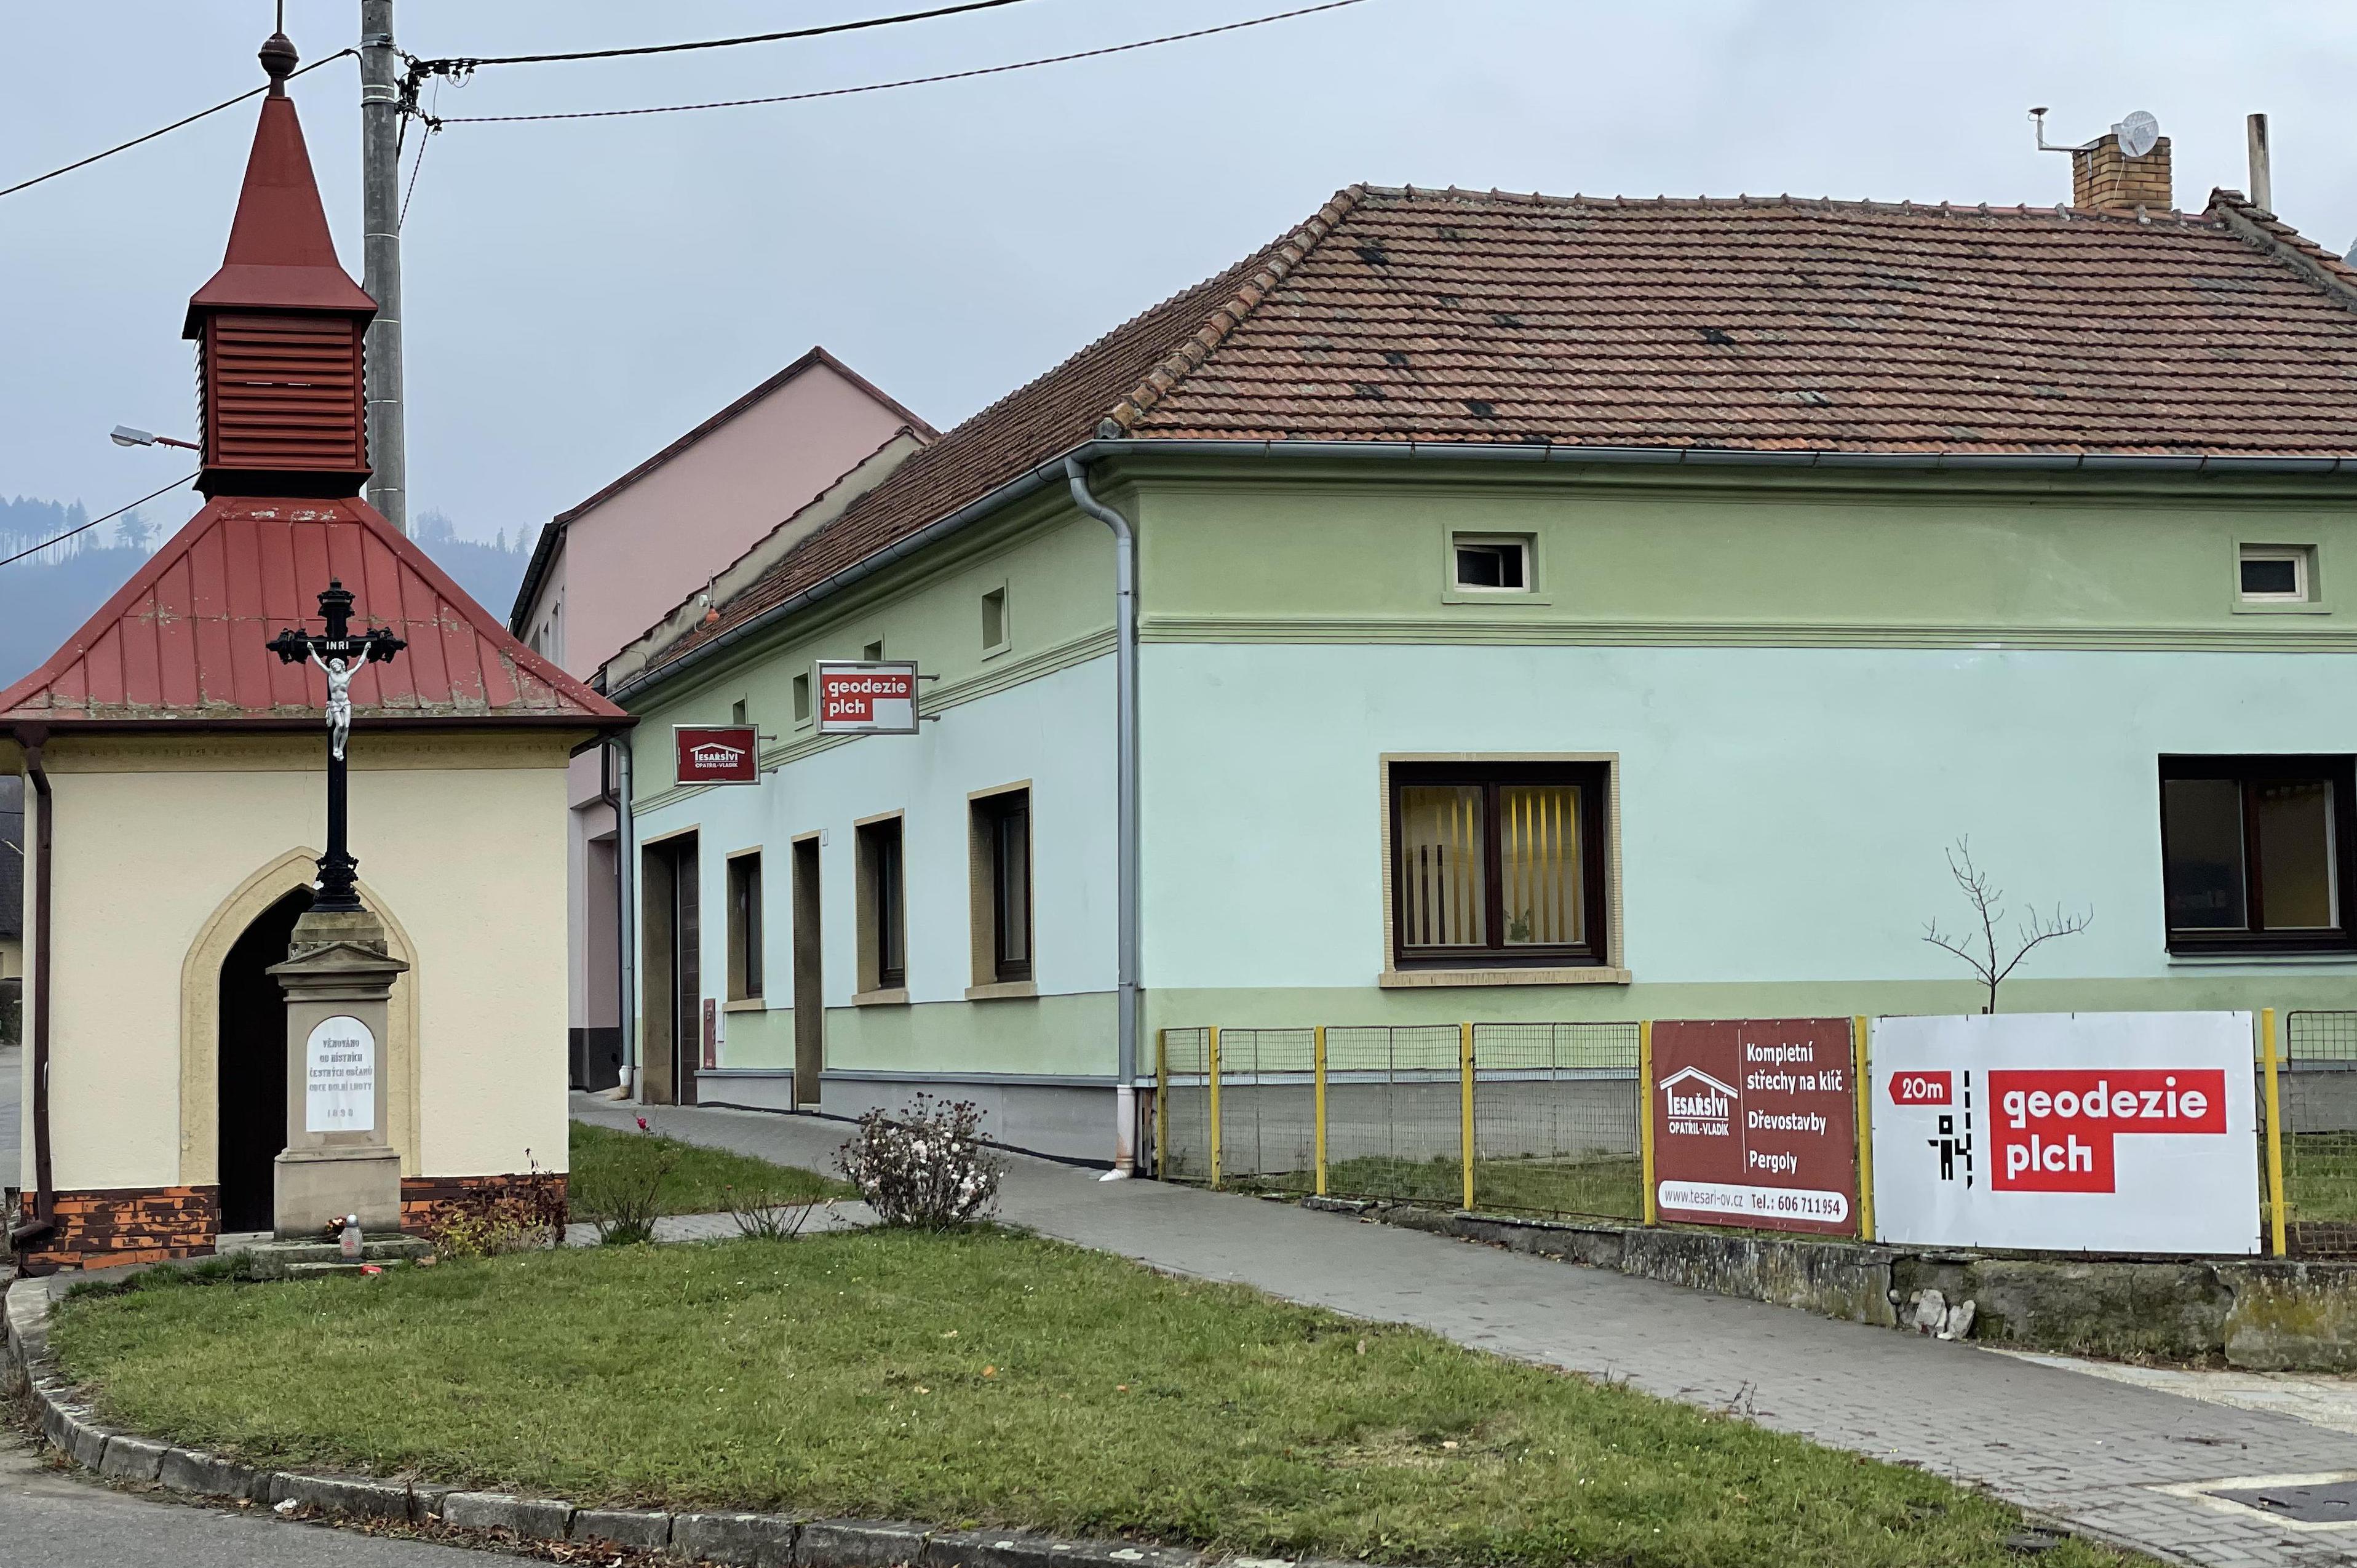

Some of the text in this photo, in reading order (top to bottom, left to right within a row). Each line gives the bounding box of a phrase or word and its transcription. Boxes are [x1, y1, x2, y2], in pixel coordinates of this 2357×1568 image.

[326, 640, 349, 650] INRI
[829, 677, 907, 697] geodezie
[830, 699, 865, 717] plch
[1747, 1041, 1813, 1067] Kompletní
[1747, 1069, 1843, 1094] střechy na klíč
[1902, 1077, 1944, 1099] 20m
[1667, 1086, 1728, 1117] TESAŘSTVÍ
[2003, 1076, 2208, 1128] geodezie
[1748, 1109, 1826, 1136] Dřevostavby
[1749, 1150, 1798, 1174] Pergoly
[2006, 1134, 2093, 1180] plch
[1664, 1189, 1743, 1208] www.tesari-ov.cz
[1752, 1194, 1775, 1210] Tel.:
[1778, 1195, 1799, 1212] 606
